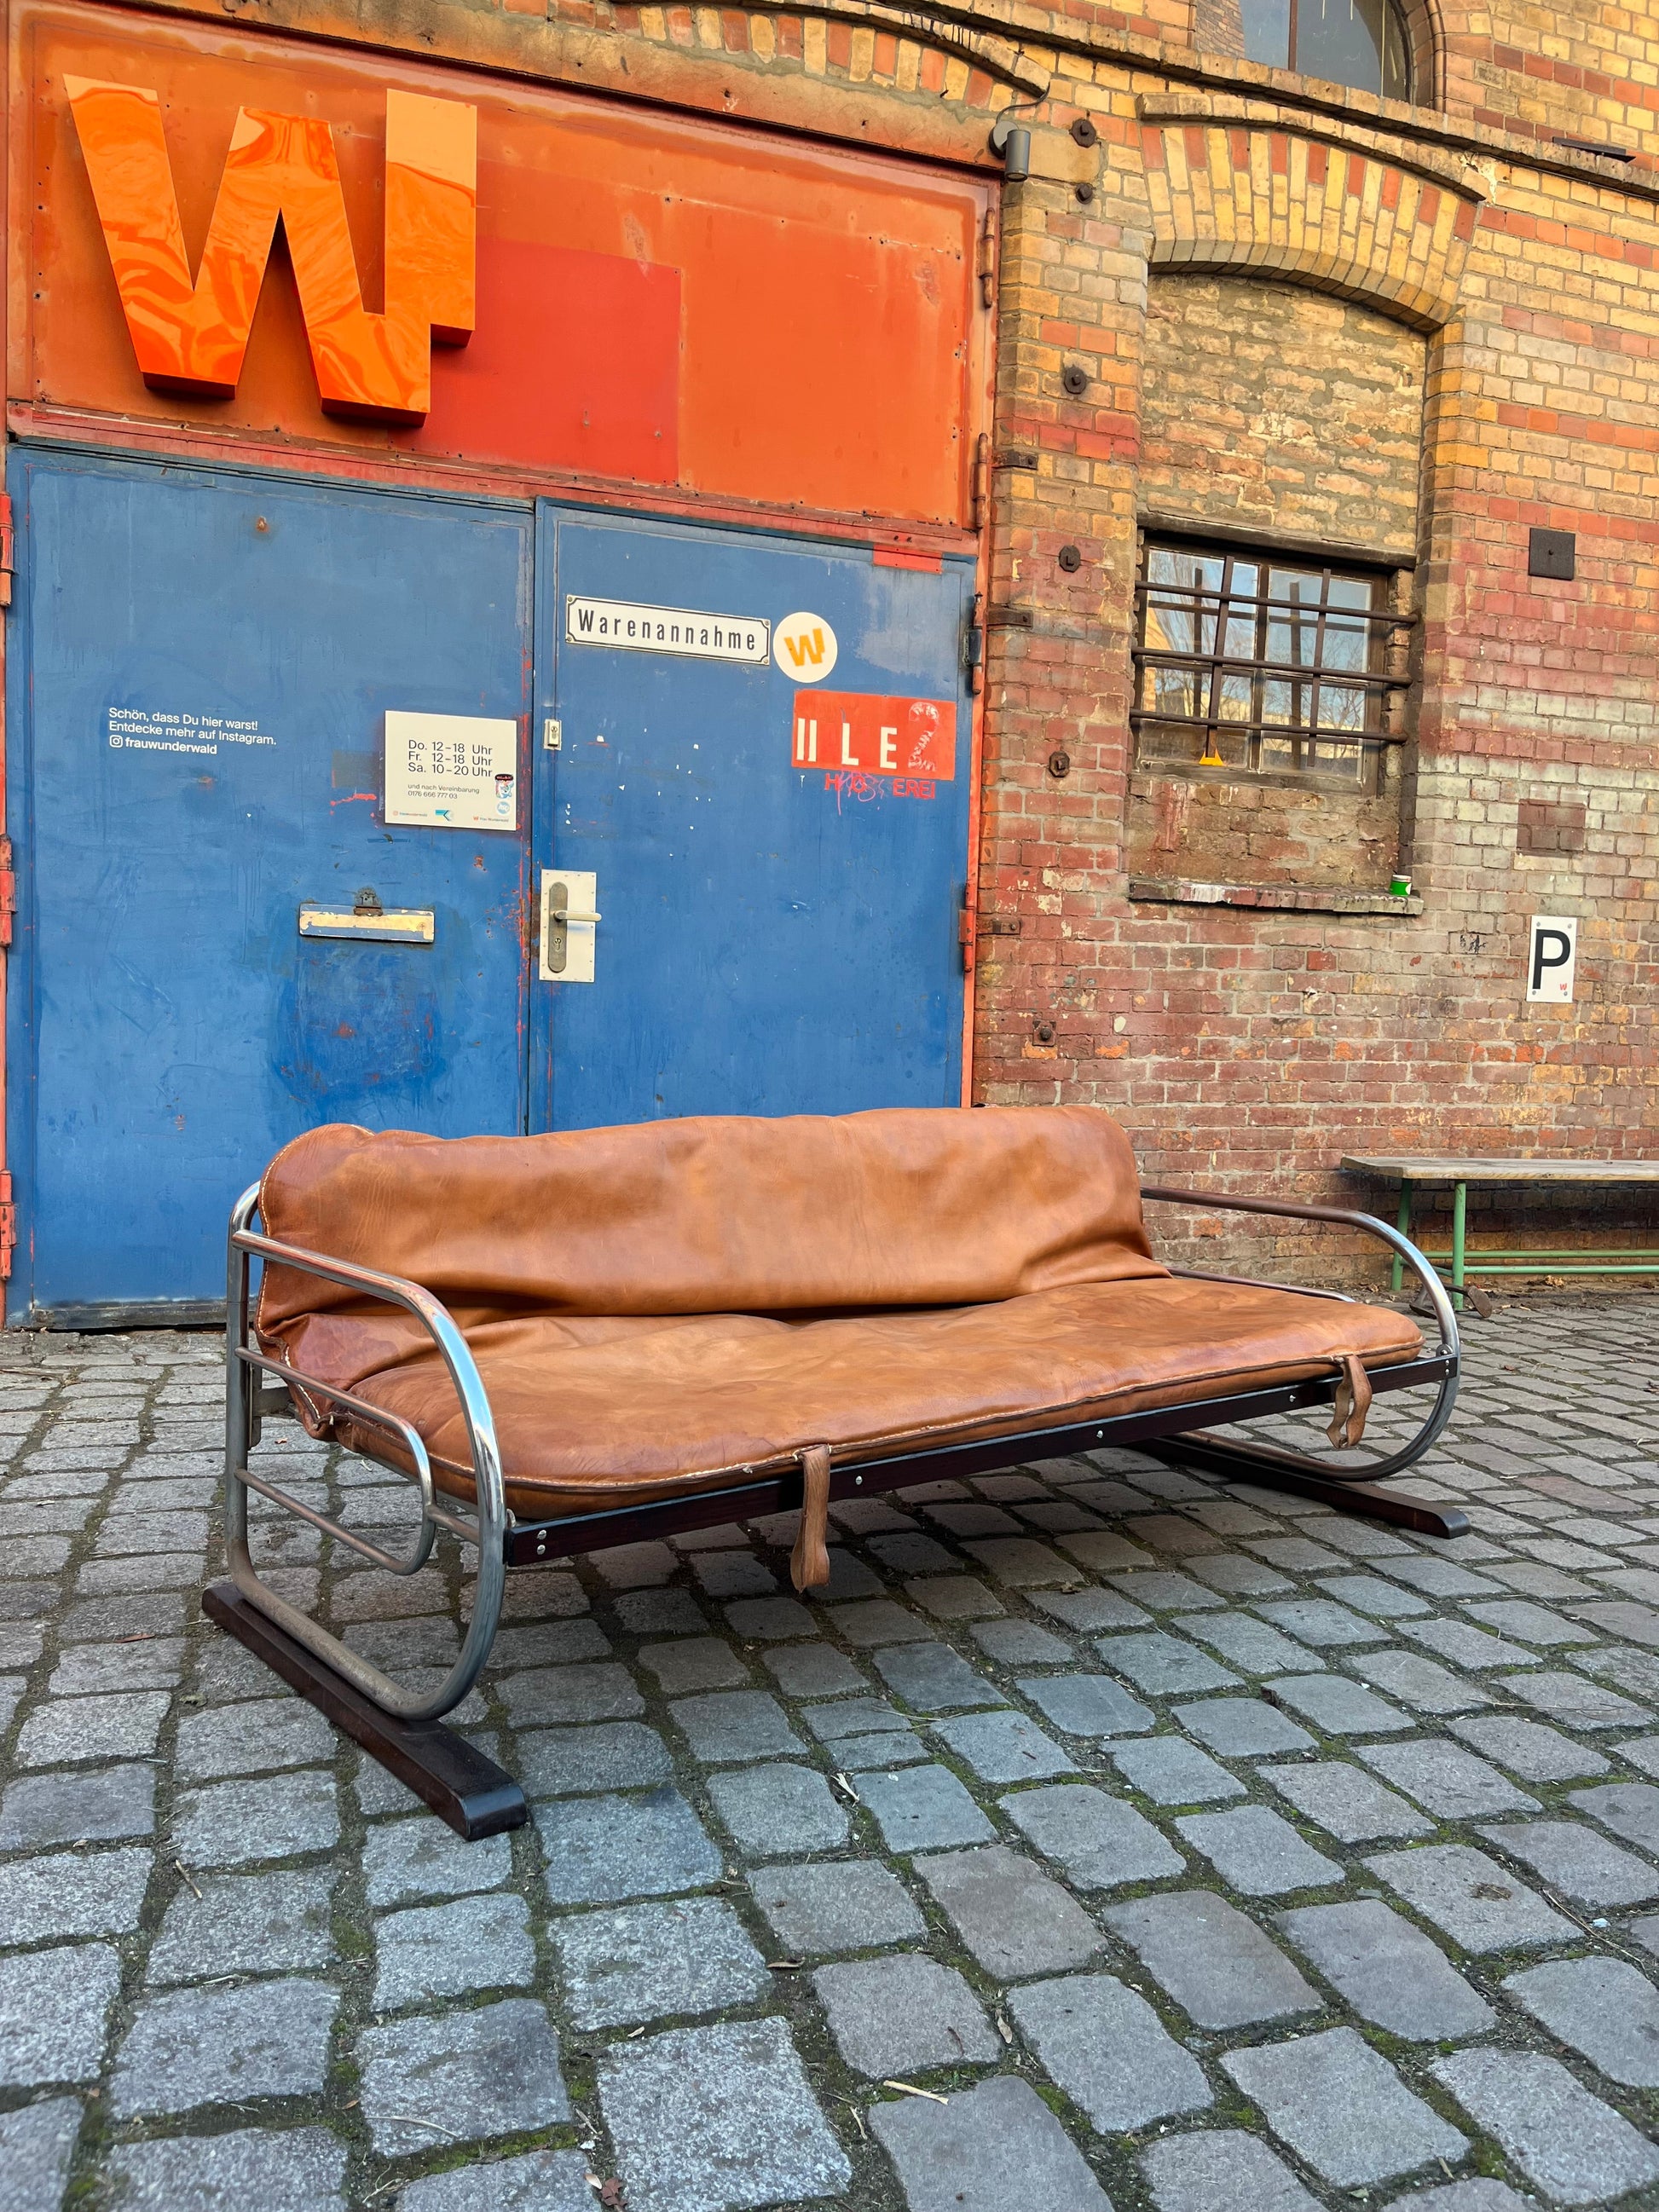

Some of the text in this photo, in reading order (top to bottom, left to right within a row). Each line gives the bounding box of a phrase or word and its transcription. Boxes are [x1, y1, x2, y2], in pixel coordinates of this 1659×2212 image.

[63, 73, 477, 418] W
[578, 609, 755, 650] Warenannahme
[783, 628, 825, 667] W
[108, 707, 258, 731] Schön, dass Du hier warst!
[109, 721, 277, 746] Entdecke mehr auf Instagram.
[125, 737, 217, 754] frauwunderwald
[408, 739, 428, 750] Do.
[472, 744, 493, 755] Uhr
[408, 751, 422, 761] Fr.
[472, 755, 493, 766] Uhr
[408, 762, 426, 773] Sa.
[472, 766, 493, 777] Uhr
[437, 784, 480, 794] Vereinbarung
[1532, 928, 1571, 990] P
